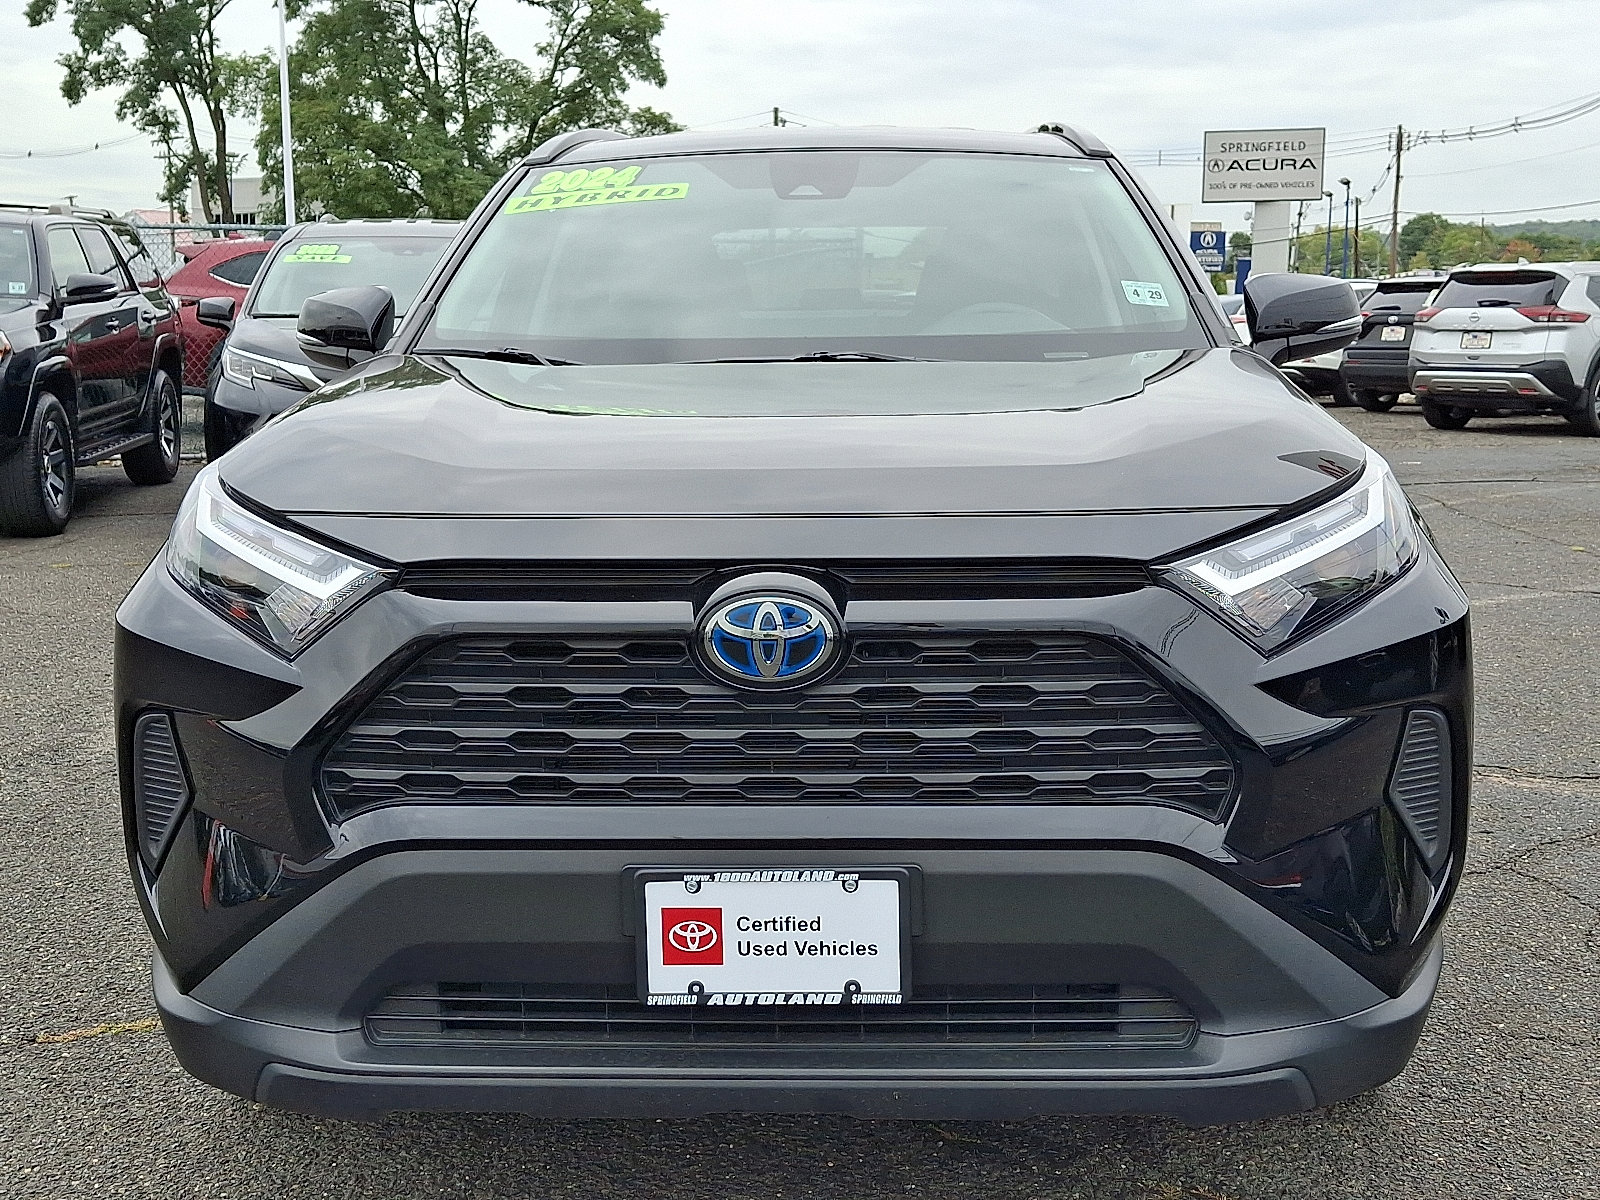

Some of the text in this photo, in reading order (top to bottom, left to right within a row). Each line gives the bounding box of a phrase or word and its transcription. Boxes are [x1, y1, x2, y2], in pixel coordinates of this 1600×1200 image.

[1220, 141, 1306, 153] SPRINGFIELD
[1226, 158, 1317, 171] ACURA
[531, 165, 642, 195] 2024
[1209, 180, 1315, 190] 100% OF PRE-OWNED VEHICLES
[514, 187, 680, 210] HYBRID
[1132, 289, 1162, 300] 4 29
[683, 870, 859, 882] www.1800AUTOLAND.com
[736, 916, 821, 932] Certified
[737, 940, 879, 956] Used Vehicles
[647, 993, 903, 1006] SPRINGFIELD AUTOLAND SPRINGFIELD
